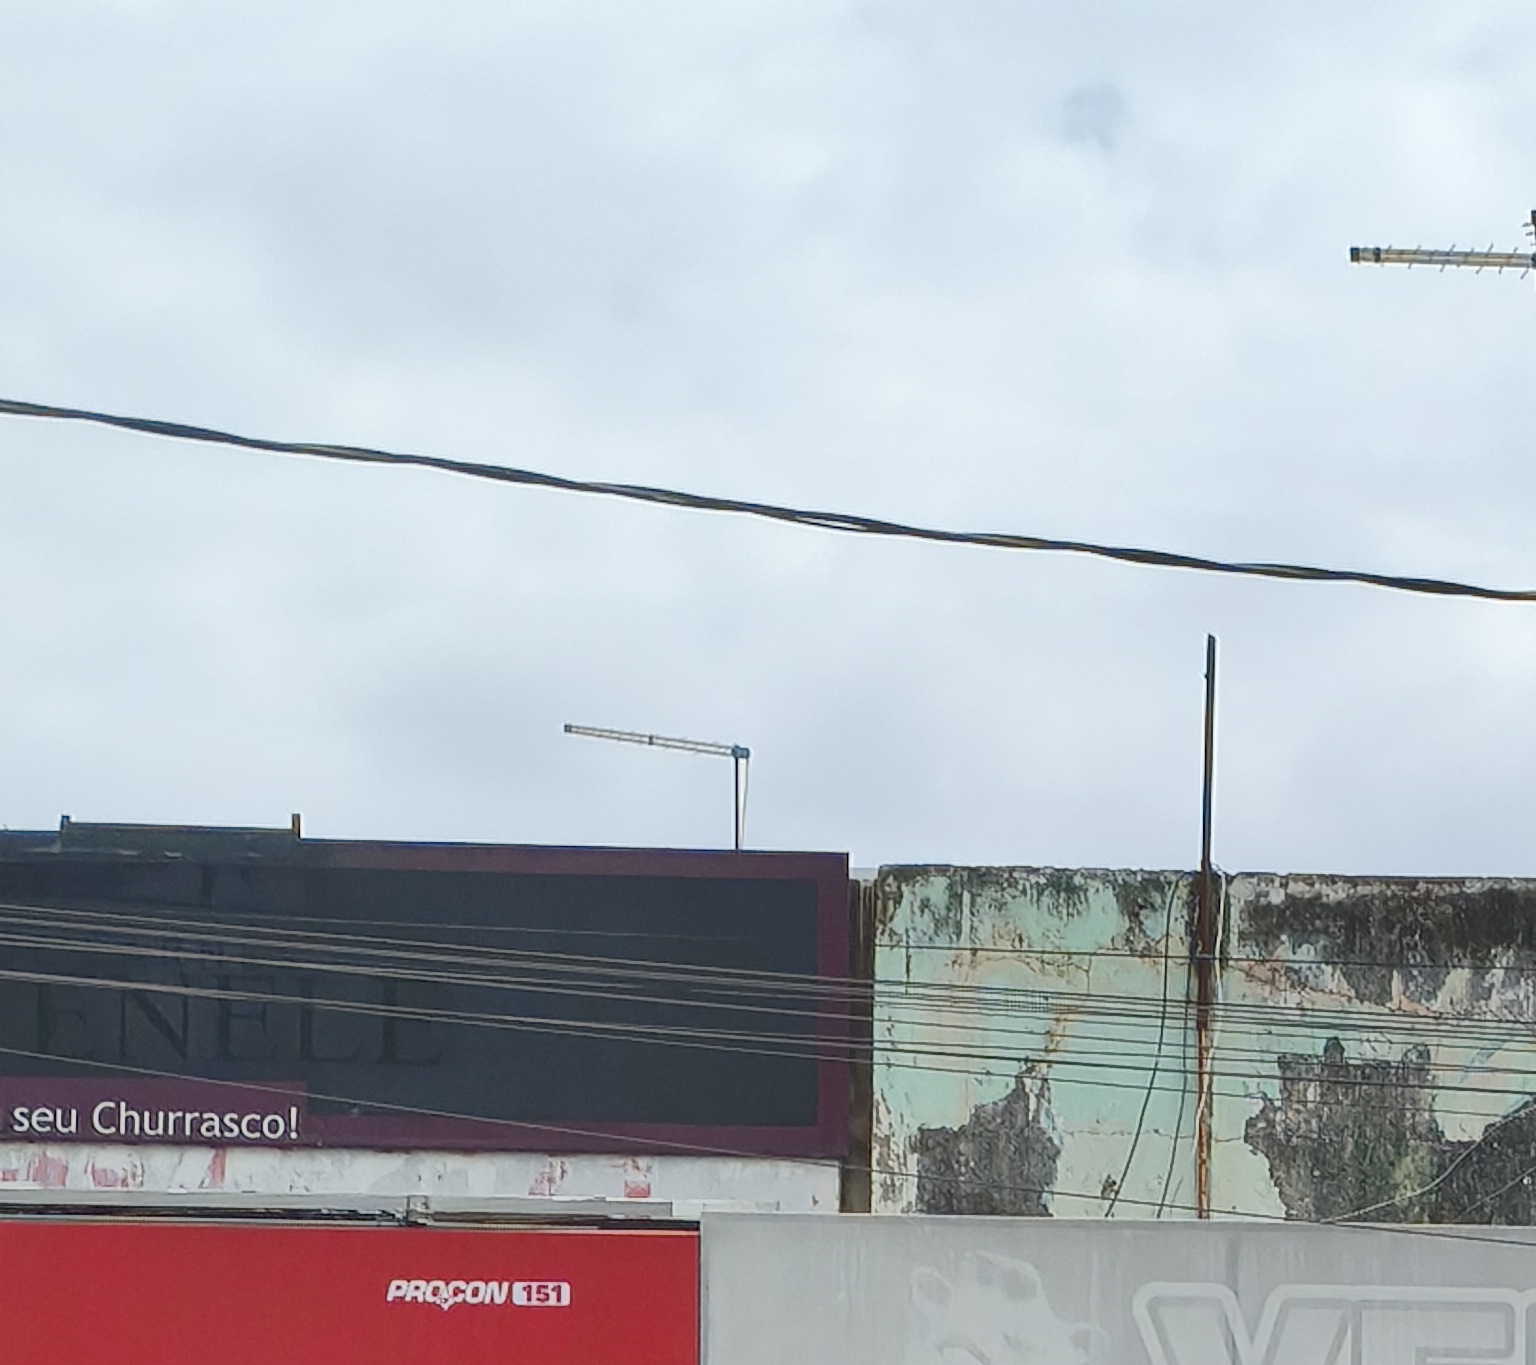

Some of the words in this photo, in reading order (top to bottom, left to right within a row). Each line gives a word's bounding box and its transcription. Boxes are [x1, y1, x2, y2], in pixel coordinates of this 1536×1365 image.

[12, 1107, 79, 1133] seu
[92, 1100, 300, 1140] Churrasco!
[386, 1279, 510, 1306] PROCON
[521, 1284, 563, 1304] 151
